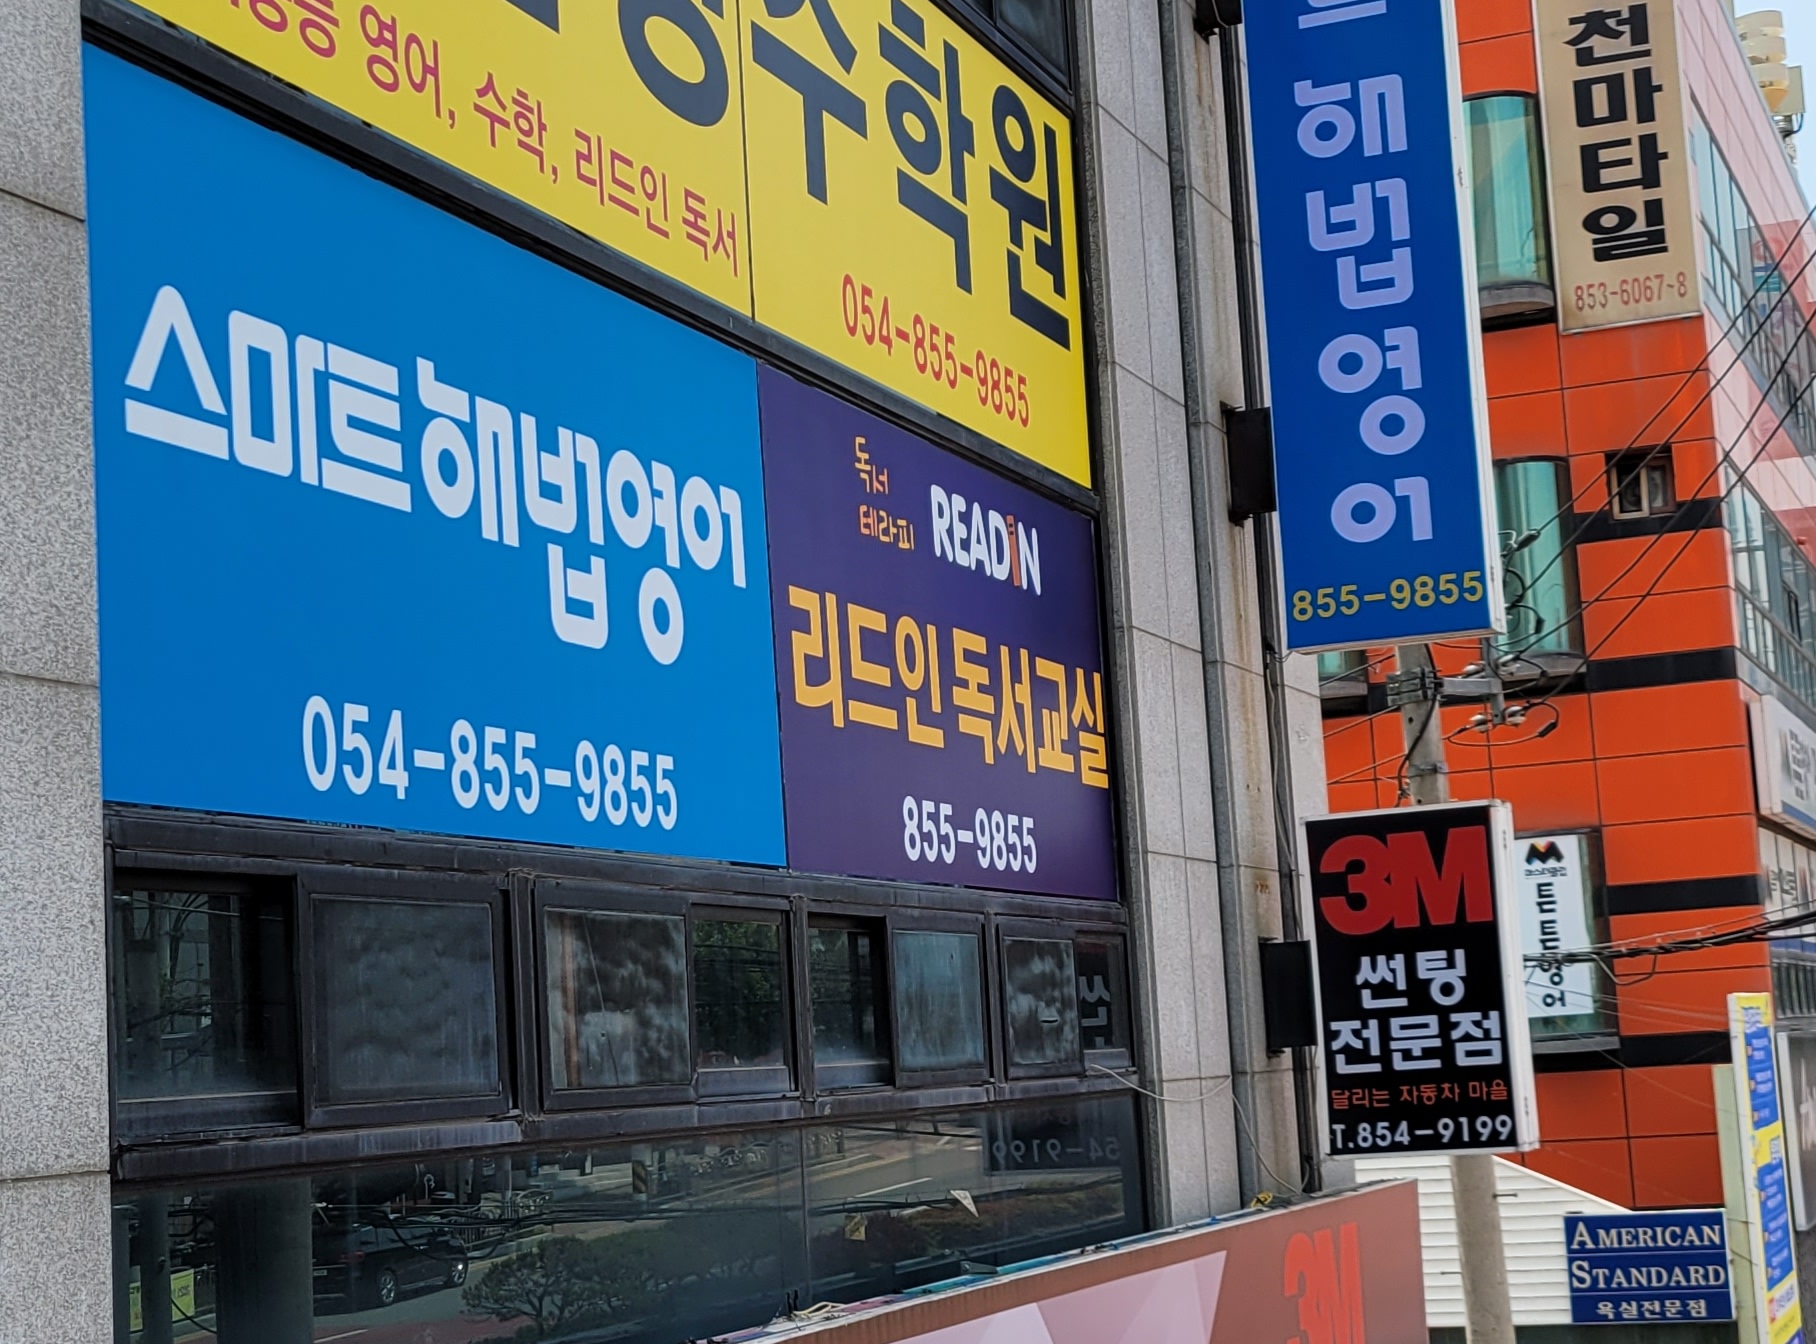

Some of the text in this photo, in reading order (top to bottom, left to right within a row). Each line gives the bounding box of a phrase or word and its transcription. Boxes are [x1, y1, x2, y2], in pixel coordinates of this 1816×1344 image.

[360, 3, 457, 130] 영어,
[472, 71, 560, 185] 수학,
[573, 127, 671, 240] 리드인
[681, 191, 739, 278] 독서
[1563, 1, 1669, 263] 천마타일
[1294, 73, 1433, 543] 해법영어
[841, 272, 1031, 430] 054-855-9855
[854, 436, 888, 495] 독서
[859, 504, 915, 551] 테라피
[1292, 570, 1485, 622] 855-9855
[302, 695, 678, 831] 054-855-9855
[902, 795, 1037, 874] 855-9855
[1319, 824, 1493, 935] 3M
[1356, 948, 1467, 1009] 썬팅
[1330, 1011, 1503, 1075] 전문점
[1331, 1078, 1508, 1110] 달리는 자동차 마을
[1332, 1115, 1513, 1149] T.854-9199
[1570, 1221, 1721, 1250] AMERICAN
[1571, 1260, 1725, 1289] STANDARD
[1595, 1299, 1708, 1320] 욕실전문점
